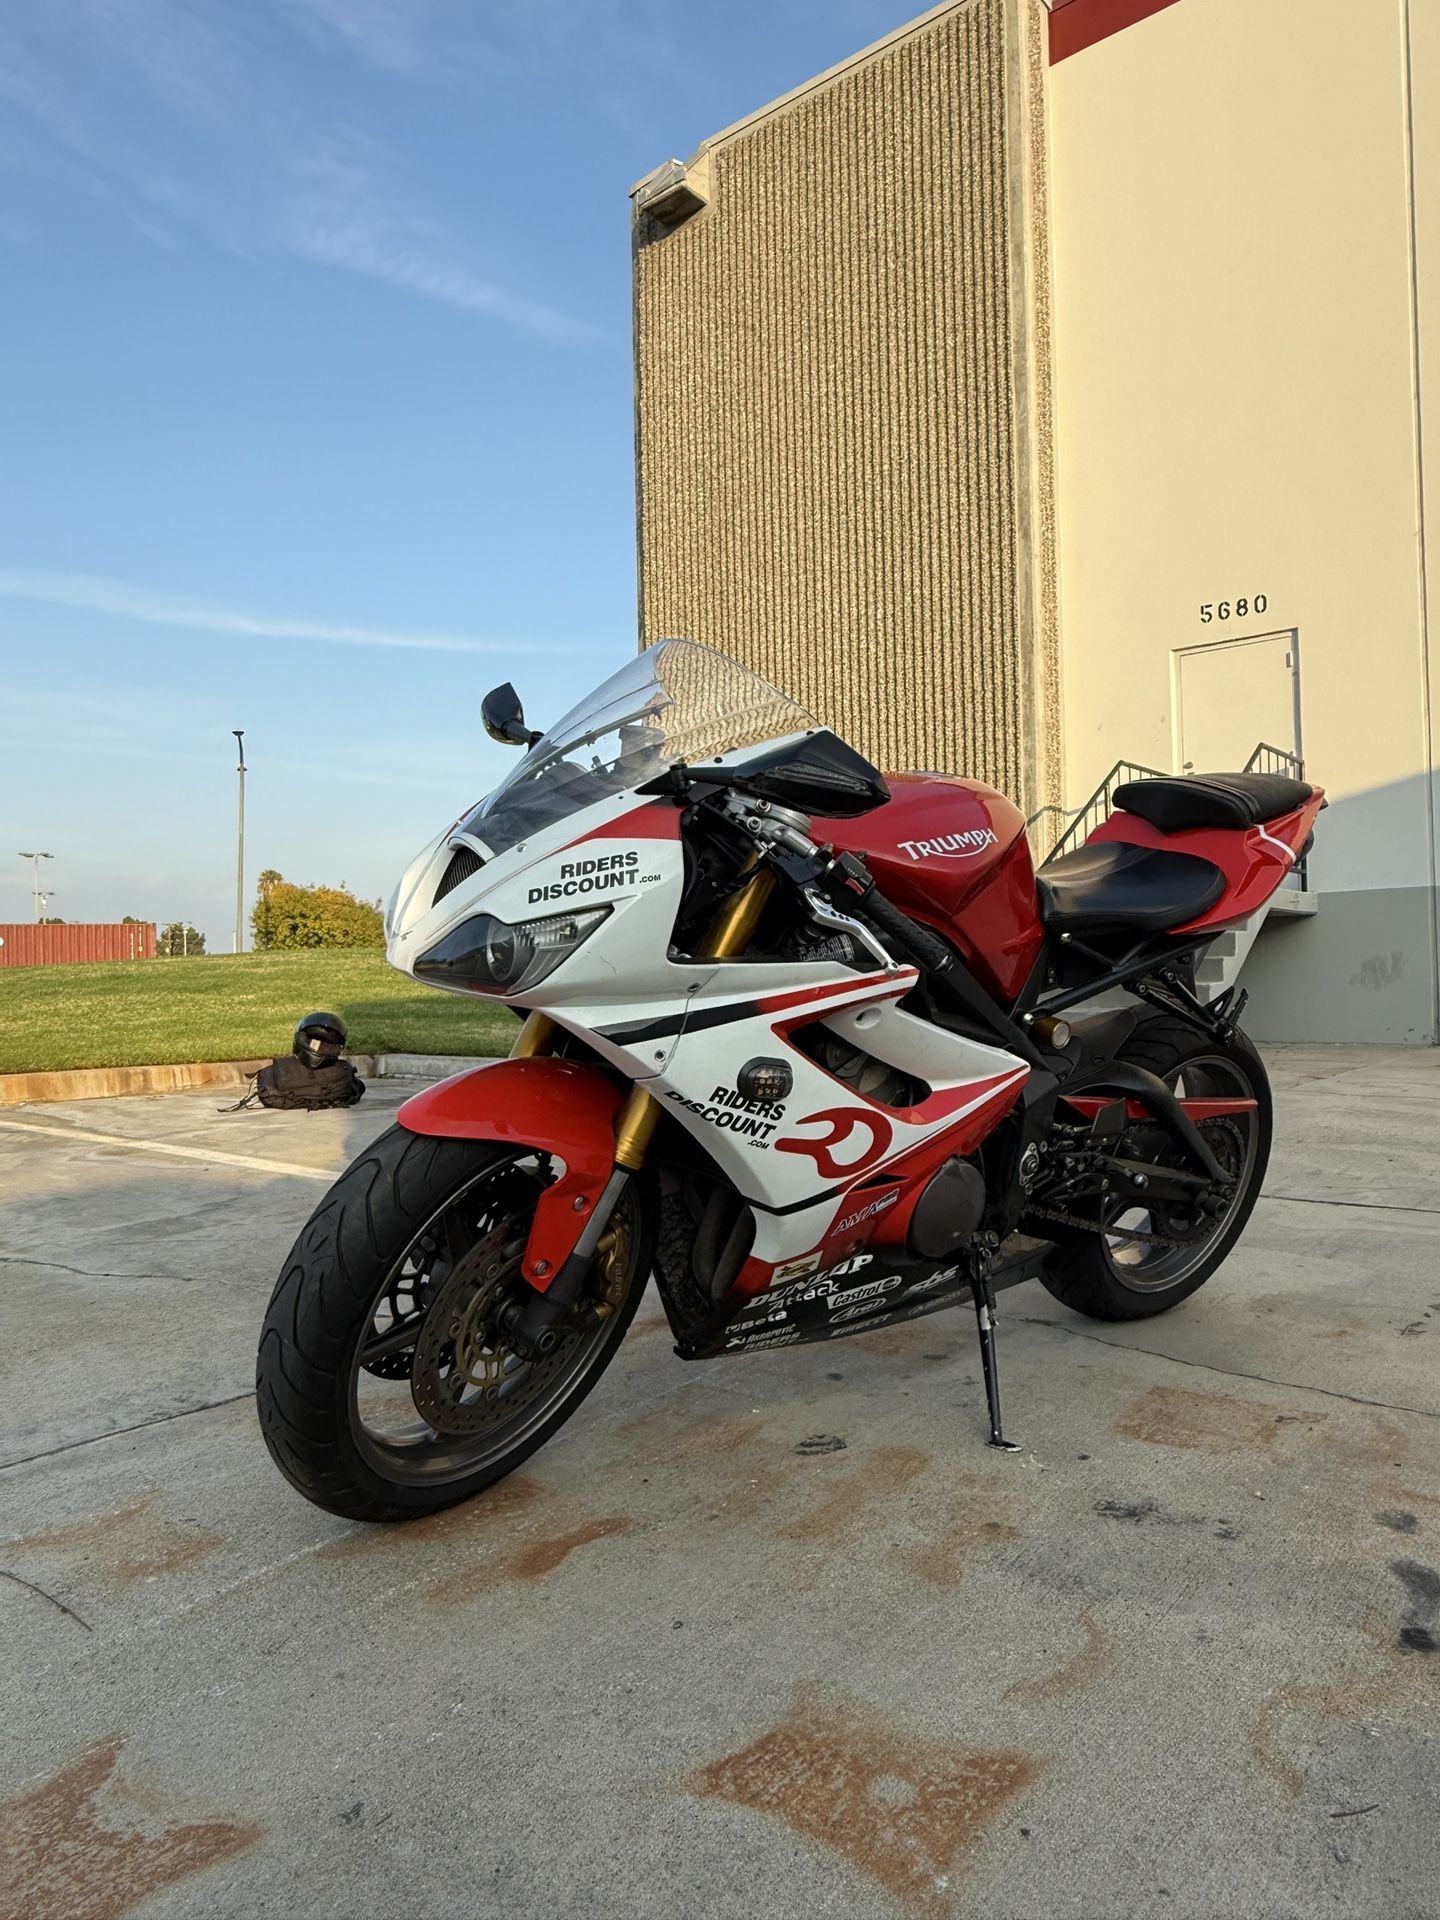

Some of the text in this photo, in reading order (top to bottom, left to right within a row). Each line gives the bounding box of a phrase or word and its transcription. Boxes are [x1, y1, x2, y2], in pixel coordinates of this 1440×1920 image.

[1200, 594, 1267, 623] 5680
[897, 828, 999, 860] TRIUMPH
[560, 851, 639, 879] RIDERS
[528, 868, 639, 904] DISCOUNT
[664, 1090, 777, 1140] DISCOUNT
[708, 1086, 786, 1121] RIDERS
[747, 1139, 770, 1150] .COM
[742, 1254, 874, 1310] DUNLOP
[833, 1282, 882, 1307] Castrol
